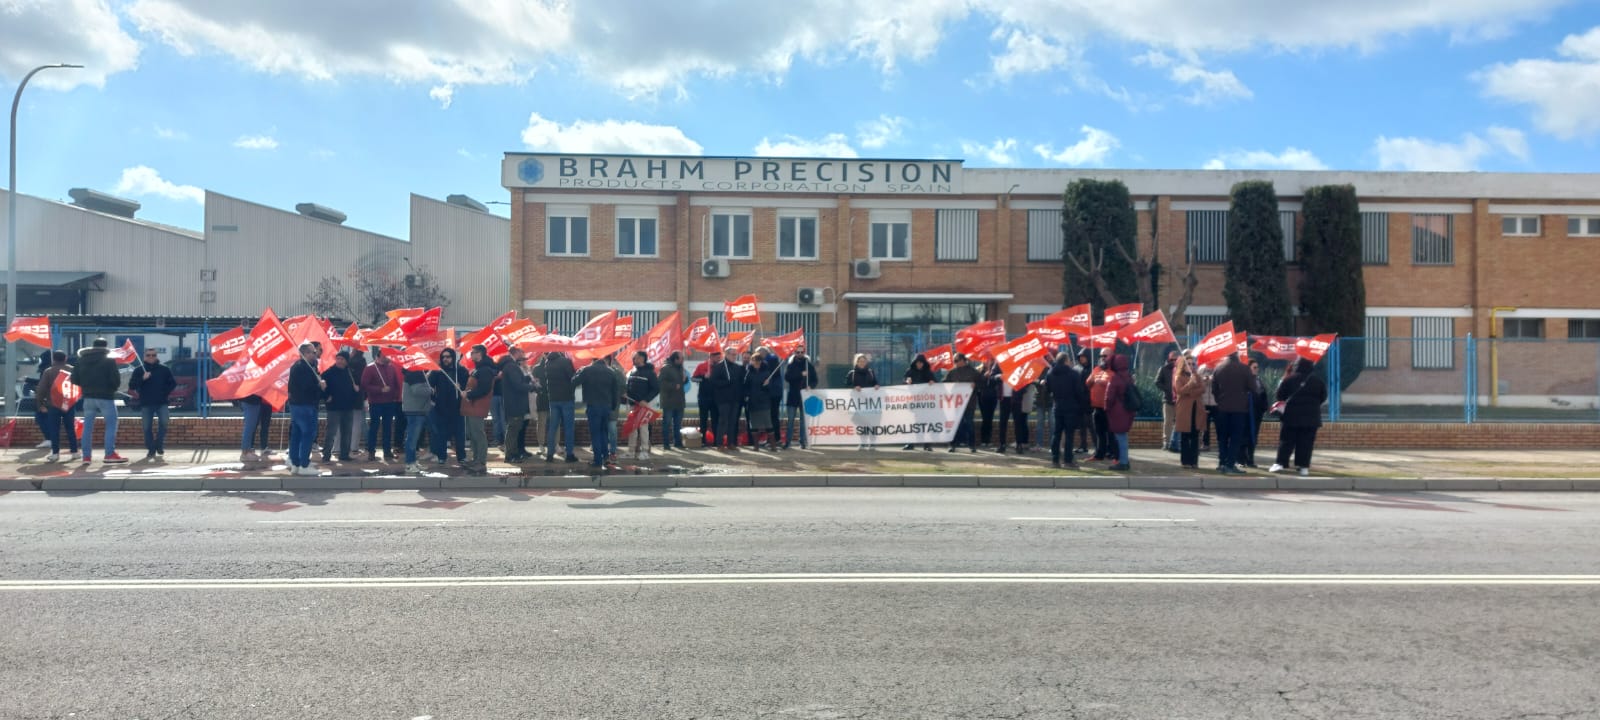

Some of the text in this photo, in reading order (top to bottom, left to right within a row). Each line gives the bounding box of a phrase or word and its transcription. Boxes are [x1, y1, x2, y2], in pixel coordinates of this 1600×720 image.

[560, 157, 952, 183] BRAHM PRECISION
[559, 178, 951, 193] PRODUCTS CORPORATION SPAIN
[825, 396, 882, 411] BRAHM
[884, 393, 936, 403] READMISIÓN
[885, 402, 936, 411] PARA DAVID
[855, 422, 944, 436] SINDICALISTAS
